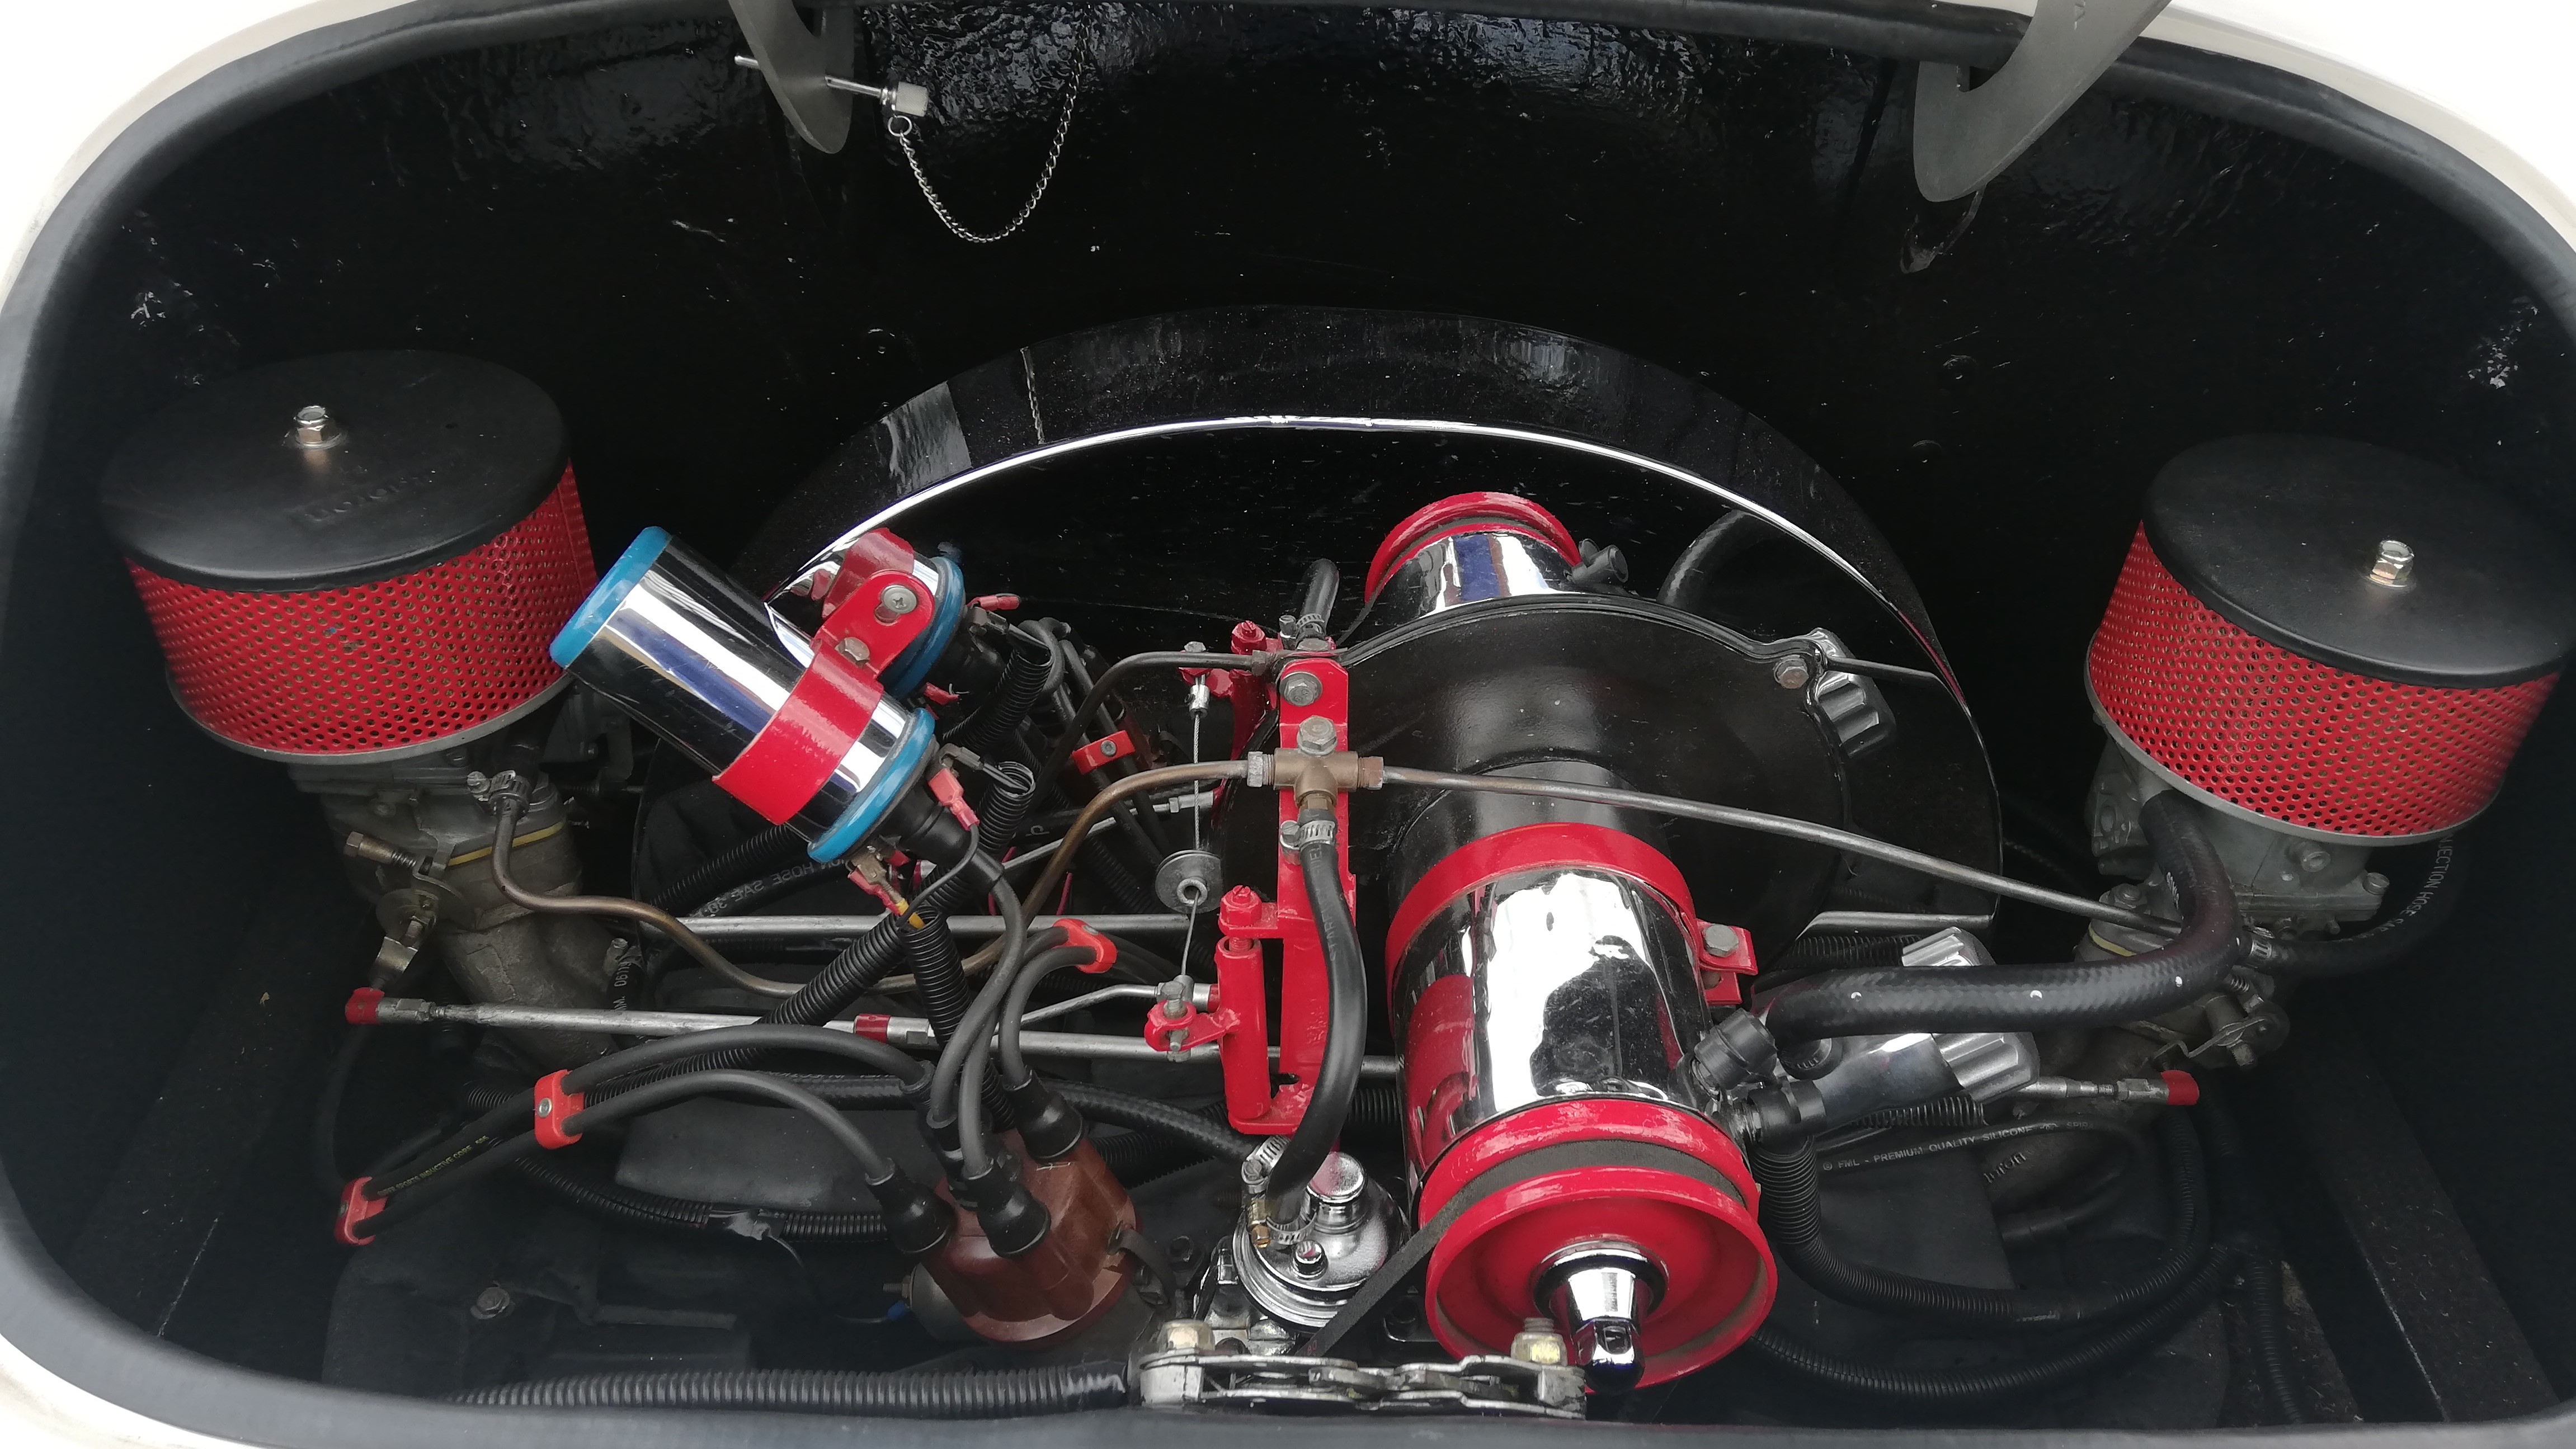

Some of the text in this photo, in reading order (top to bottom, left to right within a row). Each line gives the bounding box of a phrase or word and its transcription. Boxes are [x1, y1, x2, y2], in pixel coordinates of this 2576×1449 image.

[2424, 834, 2453, 889] NJECTION
[420, 1157, 454, 1179] INDUCTIVE
[453, 1145, 473, 1159] CORE
[1873, 1146, 1923, 1163] PREMIUM
[1929, 1135, 1976, 1153] QUALITY
[1982, 1125, 2033, 1141] SILICONE
